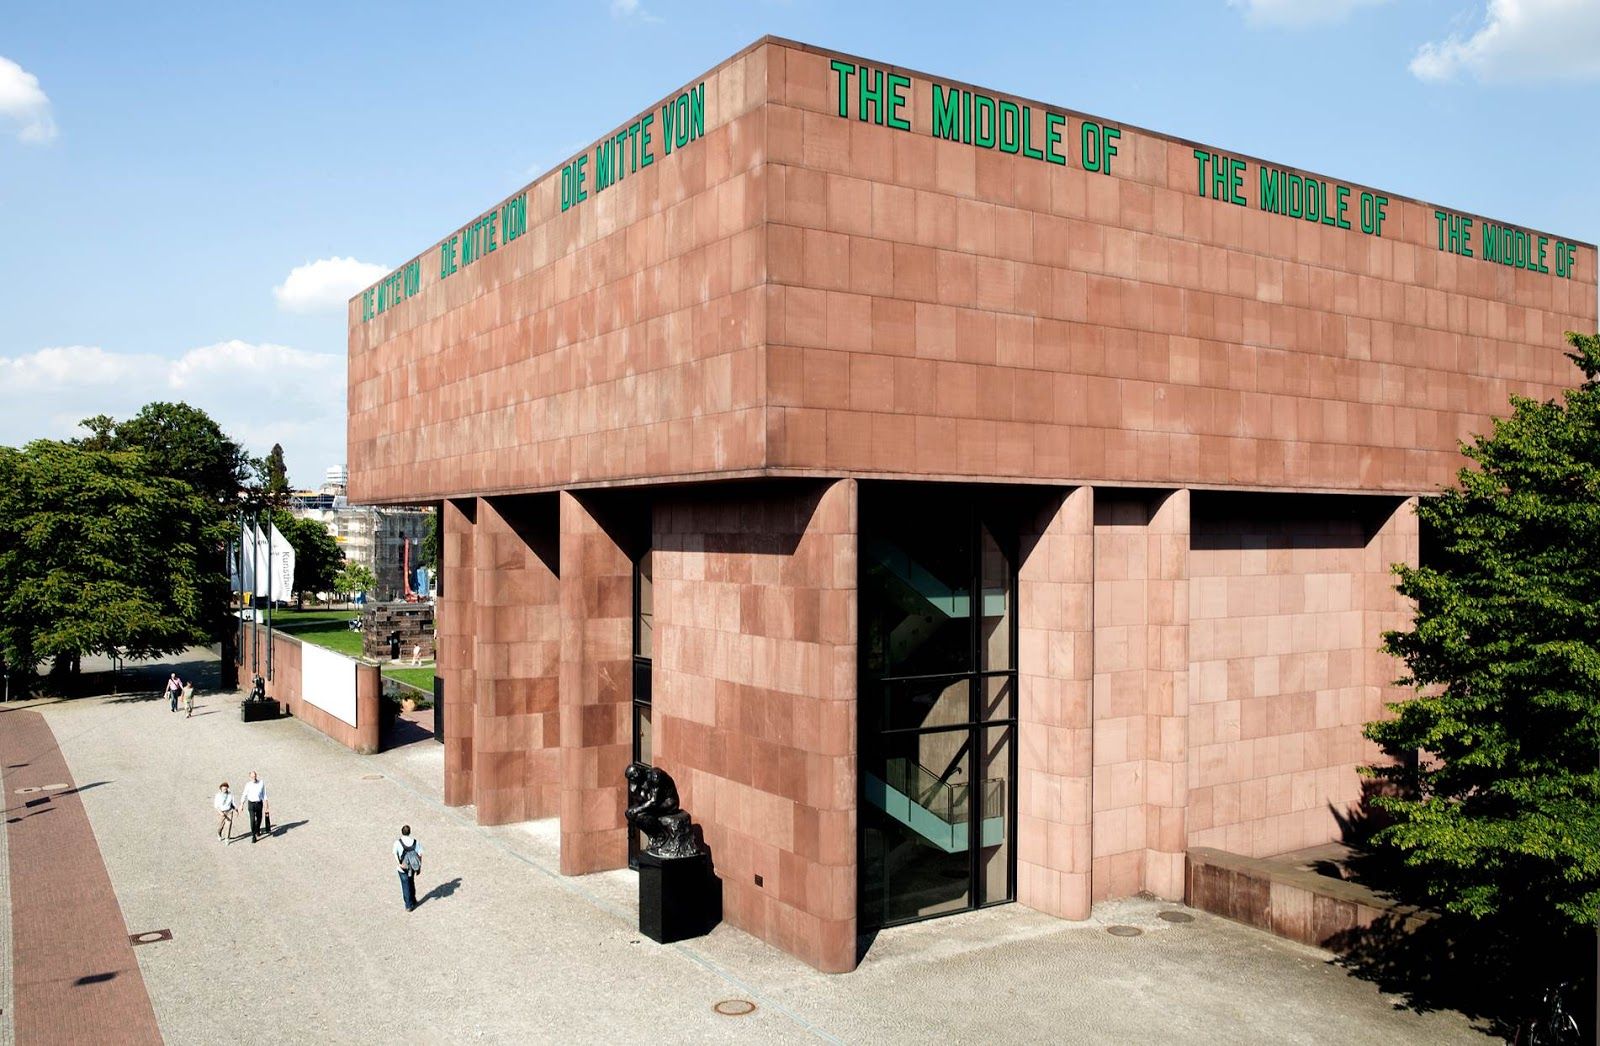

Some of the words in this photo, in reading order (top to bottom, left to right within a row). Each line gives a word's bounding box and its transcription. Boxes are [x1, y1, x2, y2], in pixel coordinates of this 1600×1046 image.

[562, 154, 588, 213] DIE
[596, 113, 654, 193] MITTE
[662, 82, 705, 156] VON
[830, 60, 911, 132] THE
[931, 83, 1067, 166] MIDDLE
[1080, 120, 1121, 177] OF
[441, 236, 458, 280] DIE
[462, 211, 497, 268] MITTE
[501, 192, 527, 246] VON
[1194, 150, 1247, 207] THE
[1259, 166, 1351, 230] MIDDLE
[1359, 191, 1389, 237] OF
[1435, 211, 1473, 257] THE
[1483, 223, 1549, 274] MIDDLE
[1555, 241, 1577, 278] OF
[363, 288, 375, 322] DIE
[377, 271, 402, 315] MITTE
[404, 259, 420, 300] VON
